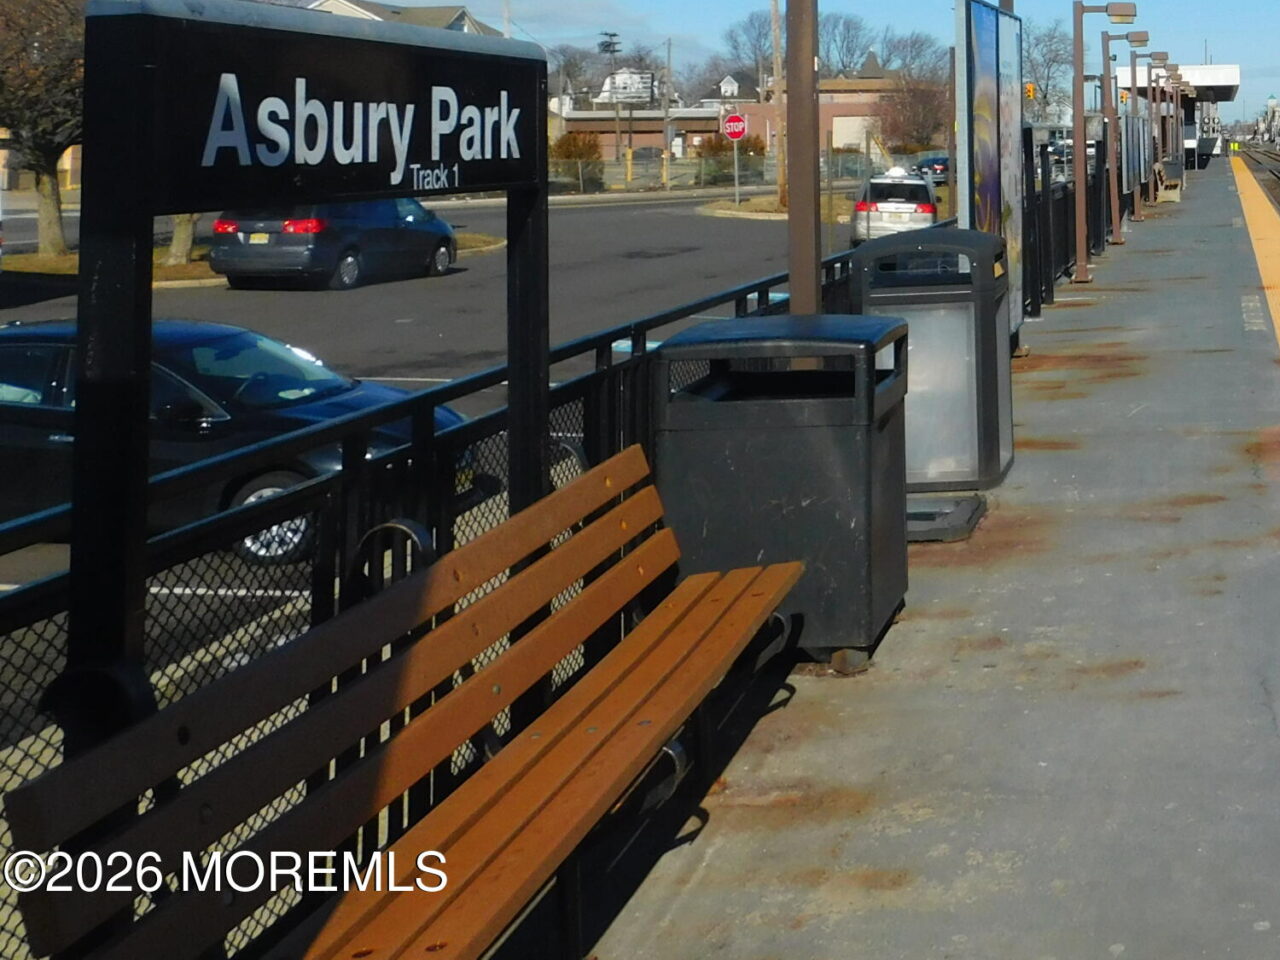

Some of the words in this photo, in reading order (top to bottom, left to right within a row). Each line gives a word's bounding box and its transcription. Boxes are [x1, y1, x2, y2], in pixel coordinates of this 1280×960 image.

[201, 72, 415, 185] Asbury
[431, 85, 521, 162] Park
[725, 122, 745, 132] STOP
[410, 163, 449, 190] Track
[452, 163, 459, 187] 1
